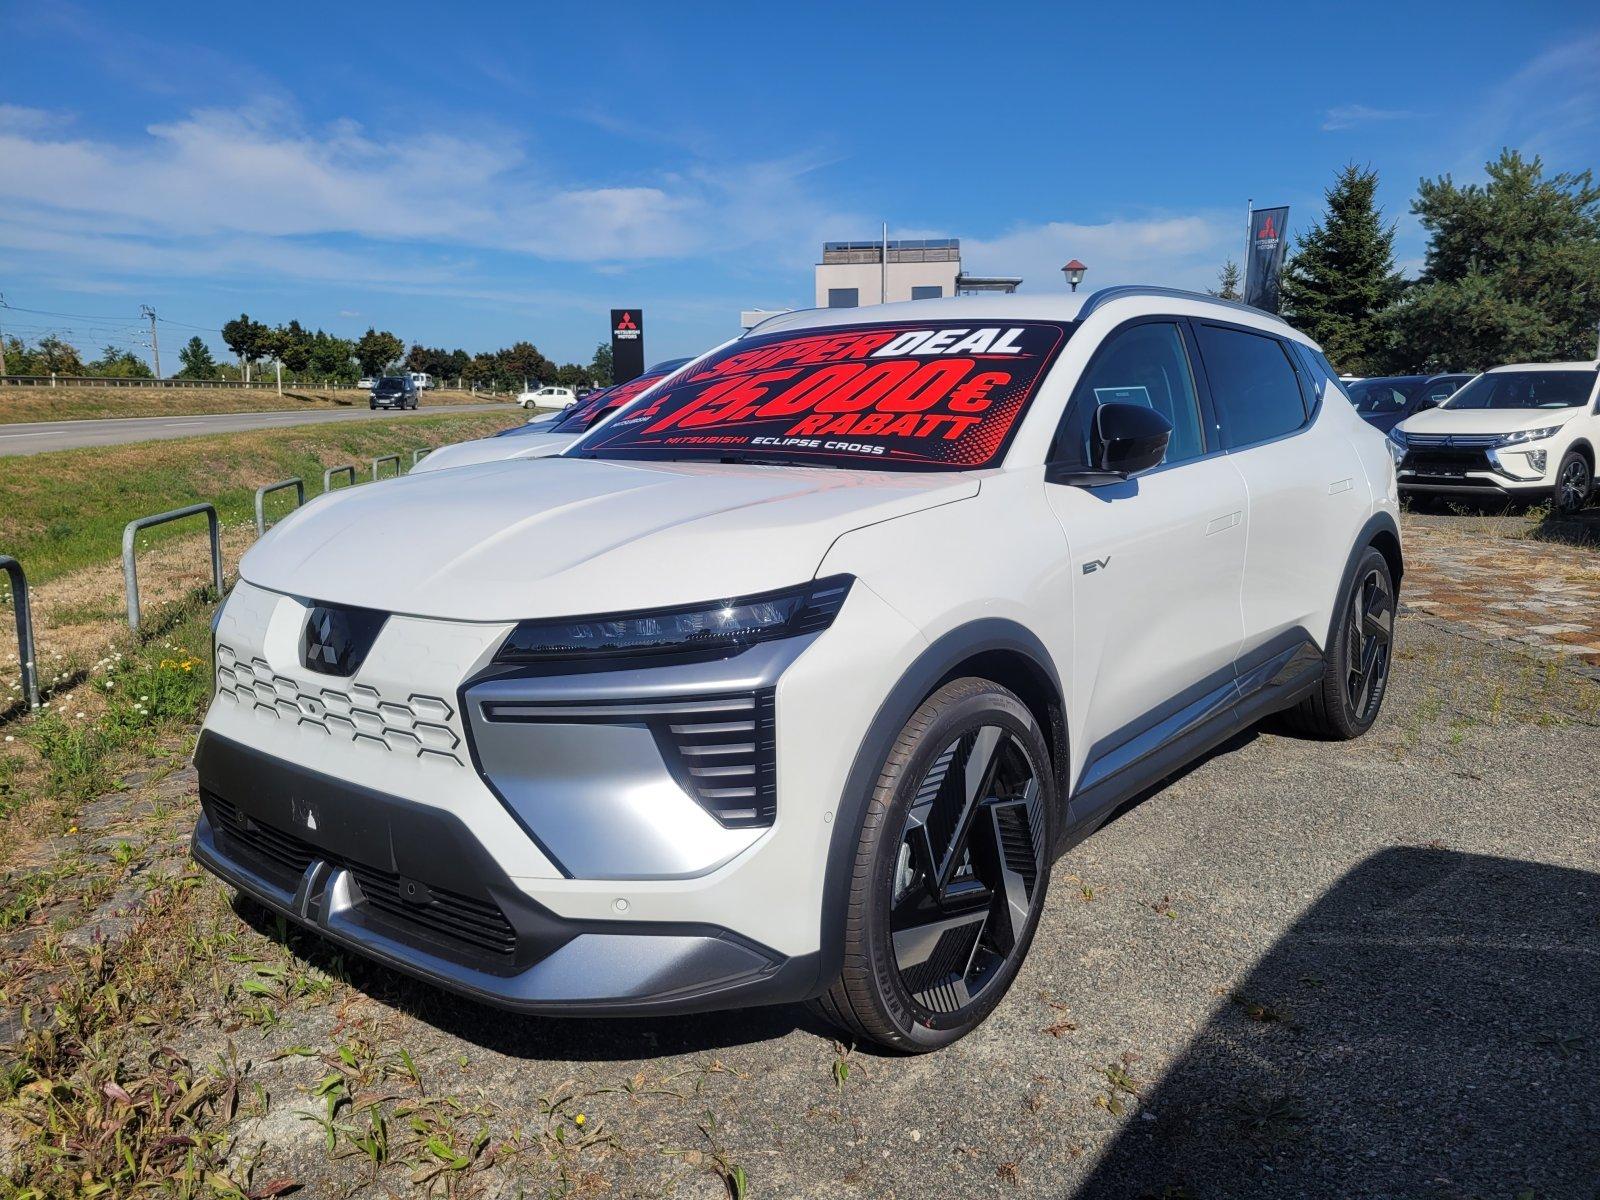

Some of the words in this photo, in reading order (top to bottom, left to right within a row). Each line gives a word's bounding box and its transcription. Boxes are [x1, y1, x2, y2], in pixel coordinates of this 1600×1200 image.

[870, 328, 1025, 358] DEAL
[784, 413, 983, 440] RABATT
[664, 436, 749, 445] MITSUBISHI
[750, 436, 822, 448] ECLIPSE
[824, 440, 885, 455] CROSS
[1082, 555, 1111, 575] EV
